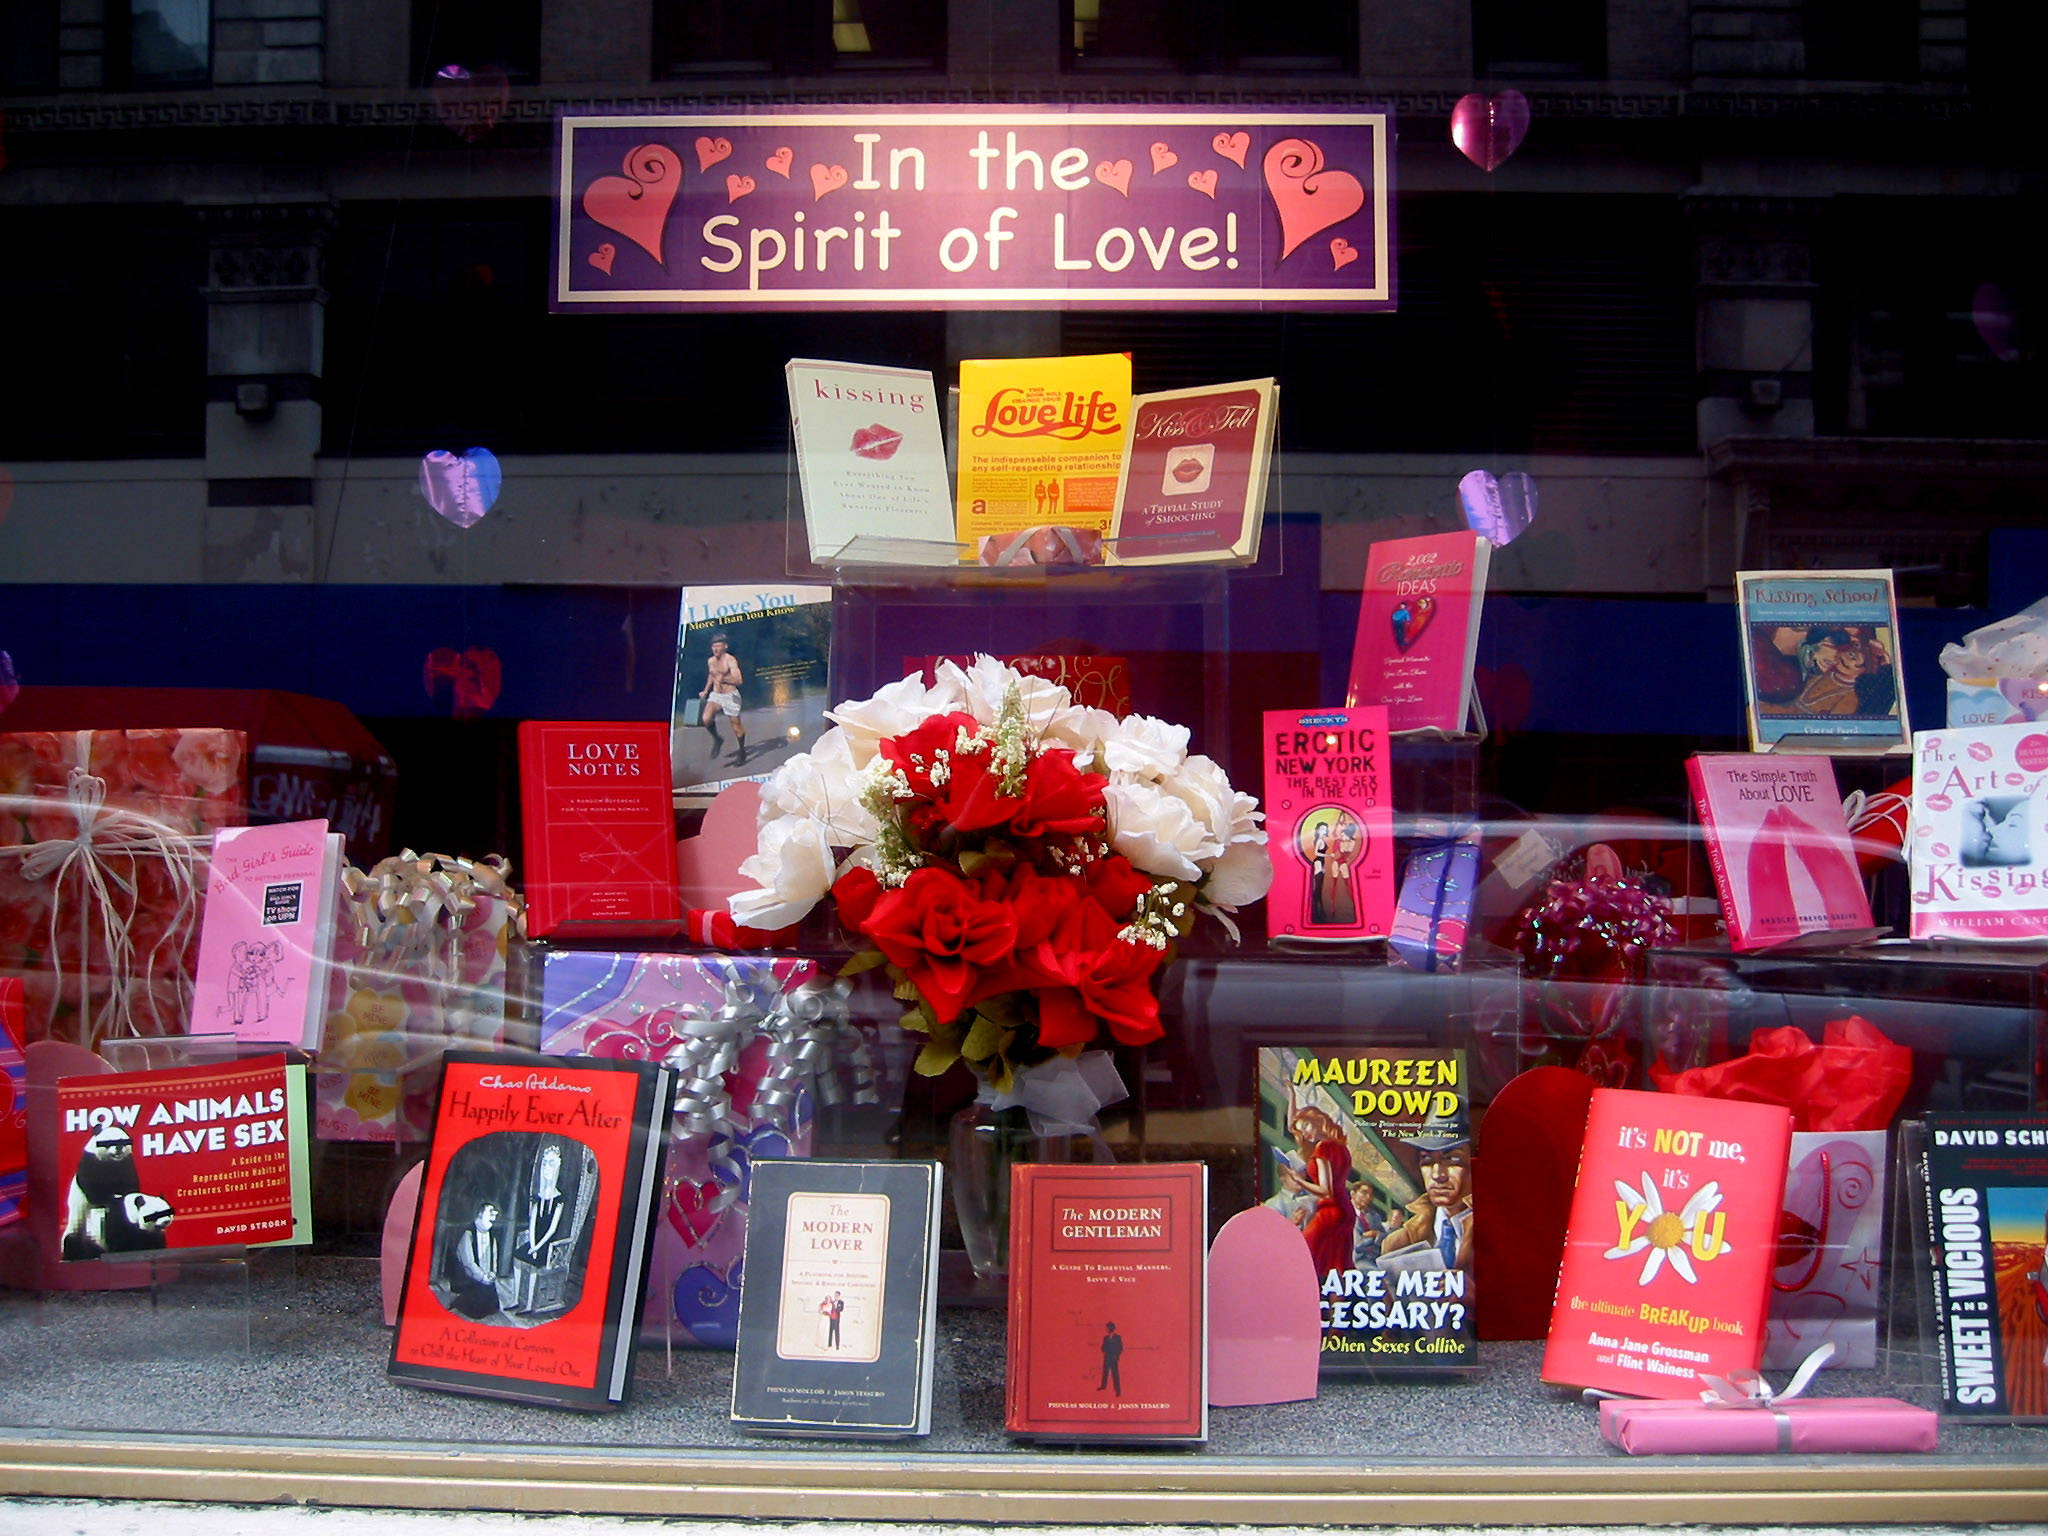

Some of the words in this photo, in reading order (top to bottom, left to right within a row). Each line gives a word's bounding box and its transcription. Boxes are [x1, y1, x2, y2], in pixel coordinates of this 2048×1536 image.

[853, 132, 925, 191] In
[969, 131, 1091, 192] the
[700, 210, 901, 290] Spirit
[938, 207, 1019, 272] of
[1054, 211, 1239, 272] Love!
[814, 378, 924, 414] kissing
[1136, 411, 1186, 439] Kiss
[1211, 404, 1256, 432] Tell
[972, 456, 989, 464] The
[991, 455, 1056, 465] indispensable
[1057, 454, 1110, 465] companion
[972, 464, 989, 473] any
[991, 462, 1063, 473] self-respecting
[971, 499, 987, 515] a
[1155, 511, 1217, 524] SMOOCHING
[1396, 578, 1437, 596] IDEAS
[688, 607, 696, 622] I
[702, 600, 751, 620] Love
[755, 591, 796, 610] You
[1755, 588, 1818, 609] Kissing
[1822, 587, 1878, 605] School
[688, 619, 715, 631] More
[717, 614, 743, 626] Than
[743, 611, 764, 621] You
[766, 606, 795, 617] Know
[1962, 713, 1996, 725] LOVE
[567, 742, 640, 760] LOVE
[1275, 729, 1375, 756] EROTIC
[1276, 758, 1317, 776] NEW
[1324, 755, 1376, 774] YORK
[1918, 750, 1957, 764] The
[568, 762, 641, 777] NOTES
[1727, 770, 1749, 783] The
[1750, 769, 1788, 785] Simple
[1788, 769, 1819, 783] Truth
[1287, 776, 1309, 789] THE
[1315, 775, 1347, 788] BEST
[1353, 774, 1378, 788] SEX
[1301, 787, 1315, 799] IN
[1321, 786, 1344, 799] THE
[1348, 783, 1378, 798] CITY
[1940, 765, 1999, 799] Art
[2023, 775, 2048, 797] of
[1739, 787, 1771, 801] About
[1771, 785, 1815, 803] LOVE
[242, 850, 277, 873] Girl's
[281, 843, 315, 860] Guide
[1937, 916, 2005, 928] WILLIAM
[1292, 1057, 1458, 1087] MAUREEN
[65, 1103, 142, 1133] HOW
[148, 1086, 285, 1127] ANIMALS
[449, 1090, 521, 1127] Happily
[525, 1095, 564, 1125] Ever
[567, 1098, 623, 1129] After
[1351, 1089, 1459, 1119] DOWD
[142, 1125, 227, 1157] HAVE
[233, 1117, 287, 1149] SEX
[1617, 1125, 1648, 1149] it's
[1653, 1127, 1705, 1158] NOT
[1708, 1138, 1747, 1165] me,
[1935, 1129, 1999, 1146] DAVID
[231, 1157, 237, 1167] A
[239, 1155, 262, 1166] Guide
[264, 1153, 273, 1162] to
[274, 1151, 286, 1161] the
[192, 1169, 250, 1183] Reproductive
[252, 1165, 277, 1177] Habits
[278, 1162, 287, 1172] of
[1662, 1167, 1690, 1190] it's
[177, 1185, 222, 1198] Creatures
[224, 1181, 248, 1193] Great
[250, 1179, 264, 1189] and
[266, 1176, 287, 1188] Small
[829, 1203, 850, 1217] The
[1062, 1207, 1085, 1222] The
[1088, 1207, 1163, 1222] MODERN
[216, 1223, 248, 1235] DAVID
[802, 1220, 874, 1234] MODERN
[1062, 1225, 1163, 1239] GENTLEMAN
[810, 1238, 863, 1251] LOVER
[1939, 1186, 1987, 1299] VICIOUS
[1321, 1268, 1387, 1298] ARE
[1396, 1269, 1465, 1299] MEN
[1570, 1296, 1590, 1311] the
[1590, 1299, 1635, 1319] ultimate
[1639, 1302, 1711, 1335] BREAKUP
[1712, 1316, 1745, 1337] book
[1951, 1301, 1989, 1312] AND
[440, 1326, 451, 1342] A
[455, 1328, 499, 1349] Collection
[502, 1334, 513, 1349] of
[1320, 1336, 1366, 1353] When
[1369, 1335, 1411, 1355] Sexes
[1414, 1335, 1466, 1354] Collide
[1588, 1331, 1619, 1350] Anna
[1620, 1336, 1650, 1355] Jane
[1651, 1341, 1710, 1364] Grossman
[446, 1346, 460, 1361] the
[526, 1356, 558, 1375] Loved
[1596, 1353, 1615, 1366] and
[1616, 1353, 1645, 1372] Flint
[1646, 1358, 1696, 1380] Wainess
[1950, 1313, 1997, 1406] SWEET
